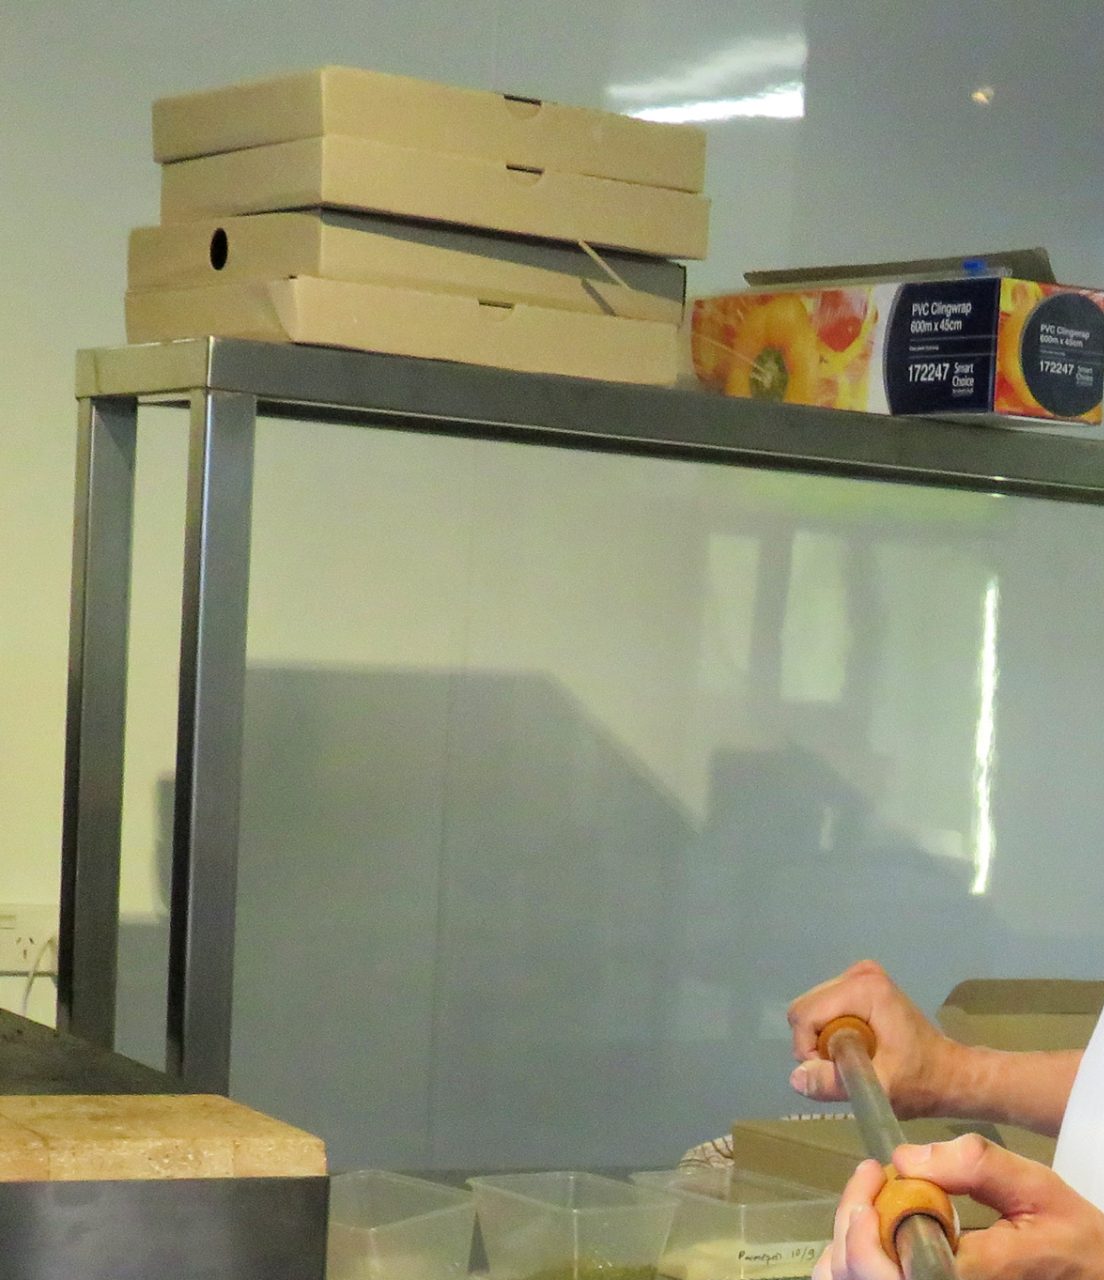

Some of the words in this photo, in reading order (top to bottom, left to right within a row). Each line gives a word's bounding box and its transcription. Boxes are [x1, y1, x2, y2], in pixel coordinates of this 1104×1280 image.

[912, 303, 929, 317] PVC
[931, 302, 972, 317] Clingwrap
[910, 320, 932, 334] 600m
[934, 323, 939, 332] x
[939, 319, 962, 331] 45cm
[1040, 324, 1056, 335] PVC
[1057, 326, 1090, 341] Clingwrap
[908, 363, 950, 382] 172247
[954, 362, 974, 374] Smart
[1040, 360, 1075, 375] 172247
[952, 376, 974, 387] Choice
